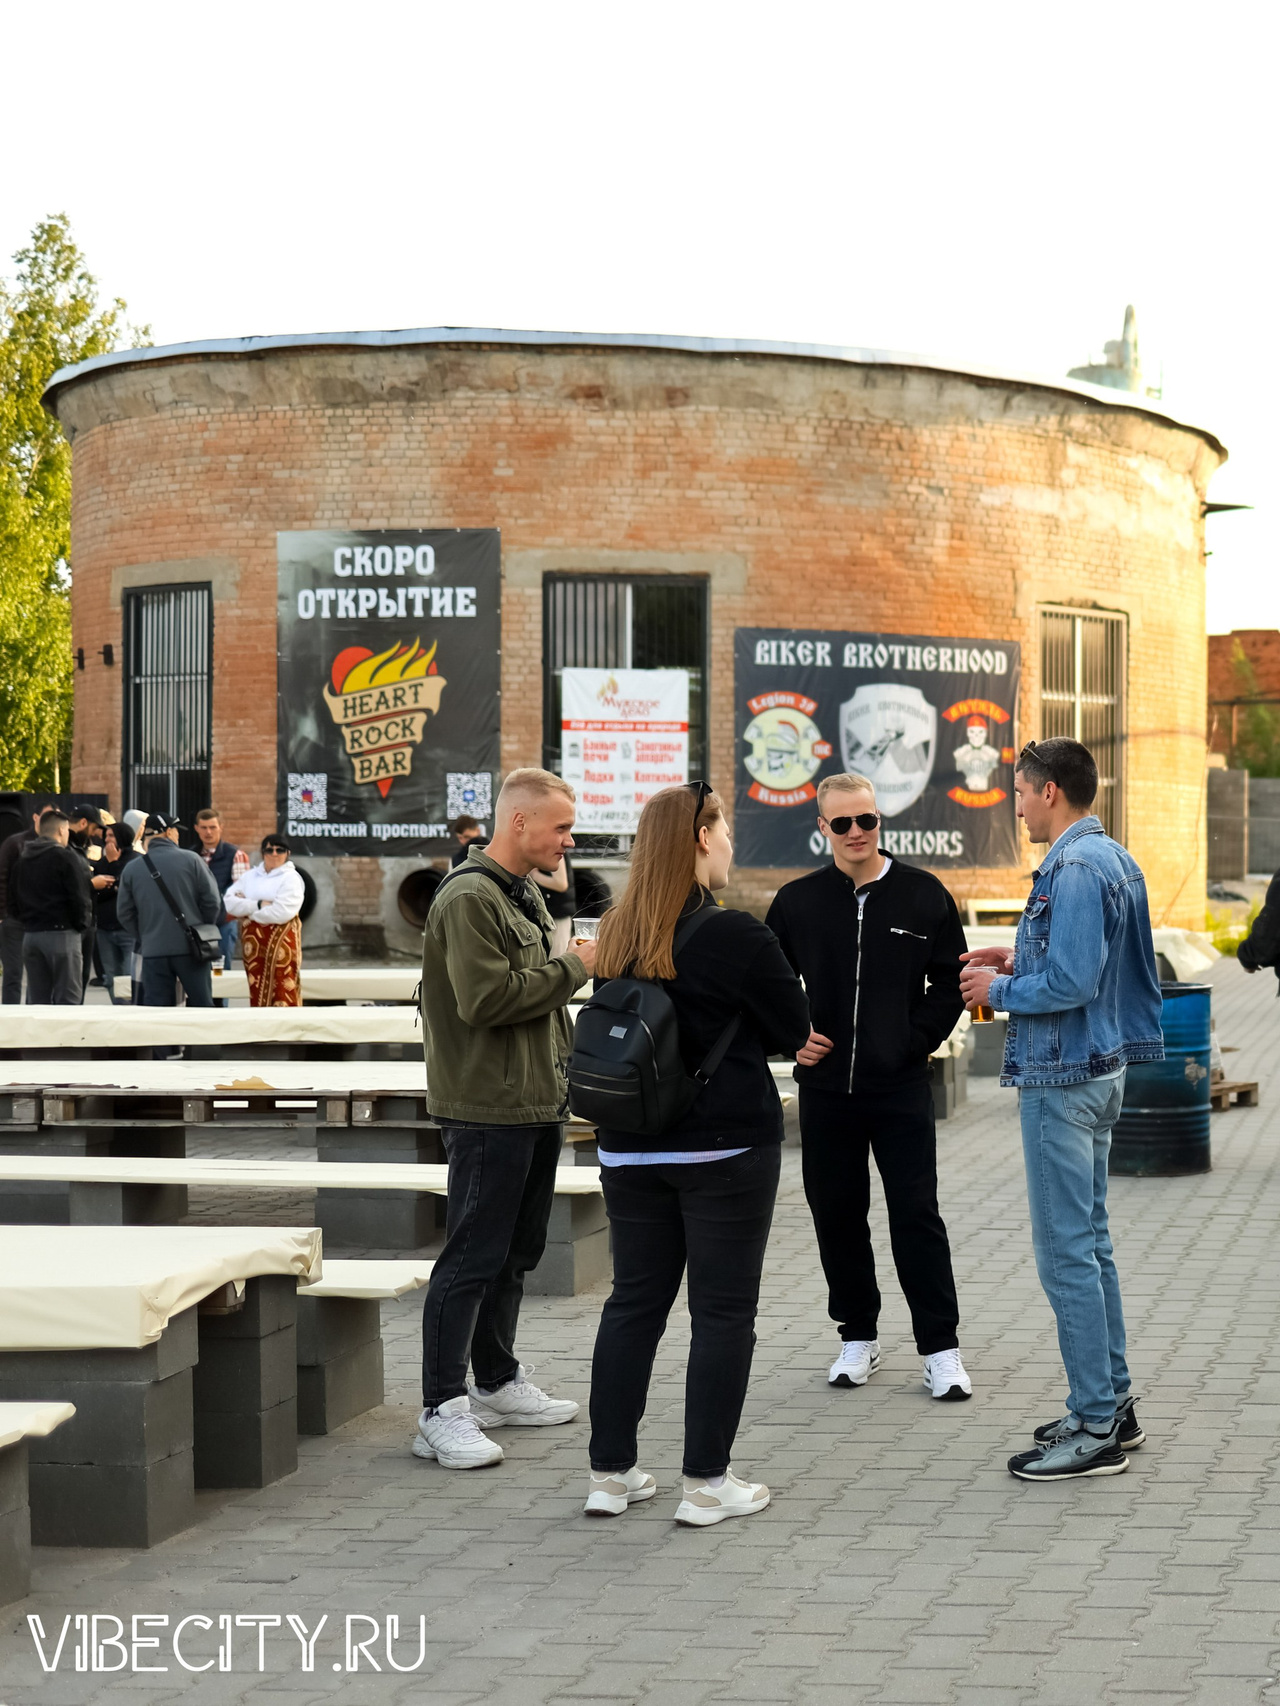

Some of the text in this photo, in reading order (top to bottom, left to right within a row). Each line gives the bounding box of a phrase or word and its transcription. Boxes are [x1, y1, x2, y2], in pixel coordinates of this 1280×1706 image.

[334, 545, 435, 577] СКОРО
[298, 587, 477, 619] ОТКРЫТИЕ
[755, 639, 1008, 675] BIKER BROTHERHOOD
[343, 682, 424, 719] HEART
[752, 692, 795, 710] Legion
[350, 716, 417, 750] ROCK
[583, 738, 617, 752] Банные
[359, 751, 407, 780] BAR
[583, 753, 609, 762] печи
[584, 770, 614, 783] Лодки
[635, 771, 683, 783] Коптильни
[583, 792, 613, 806] Нарды
[758, 788, 808, 804] Russia
[288, 821, 450, 841] Советский проспект,
[876, 832, 963, 859] ARRIORS
